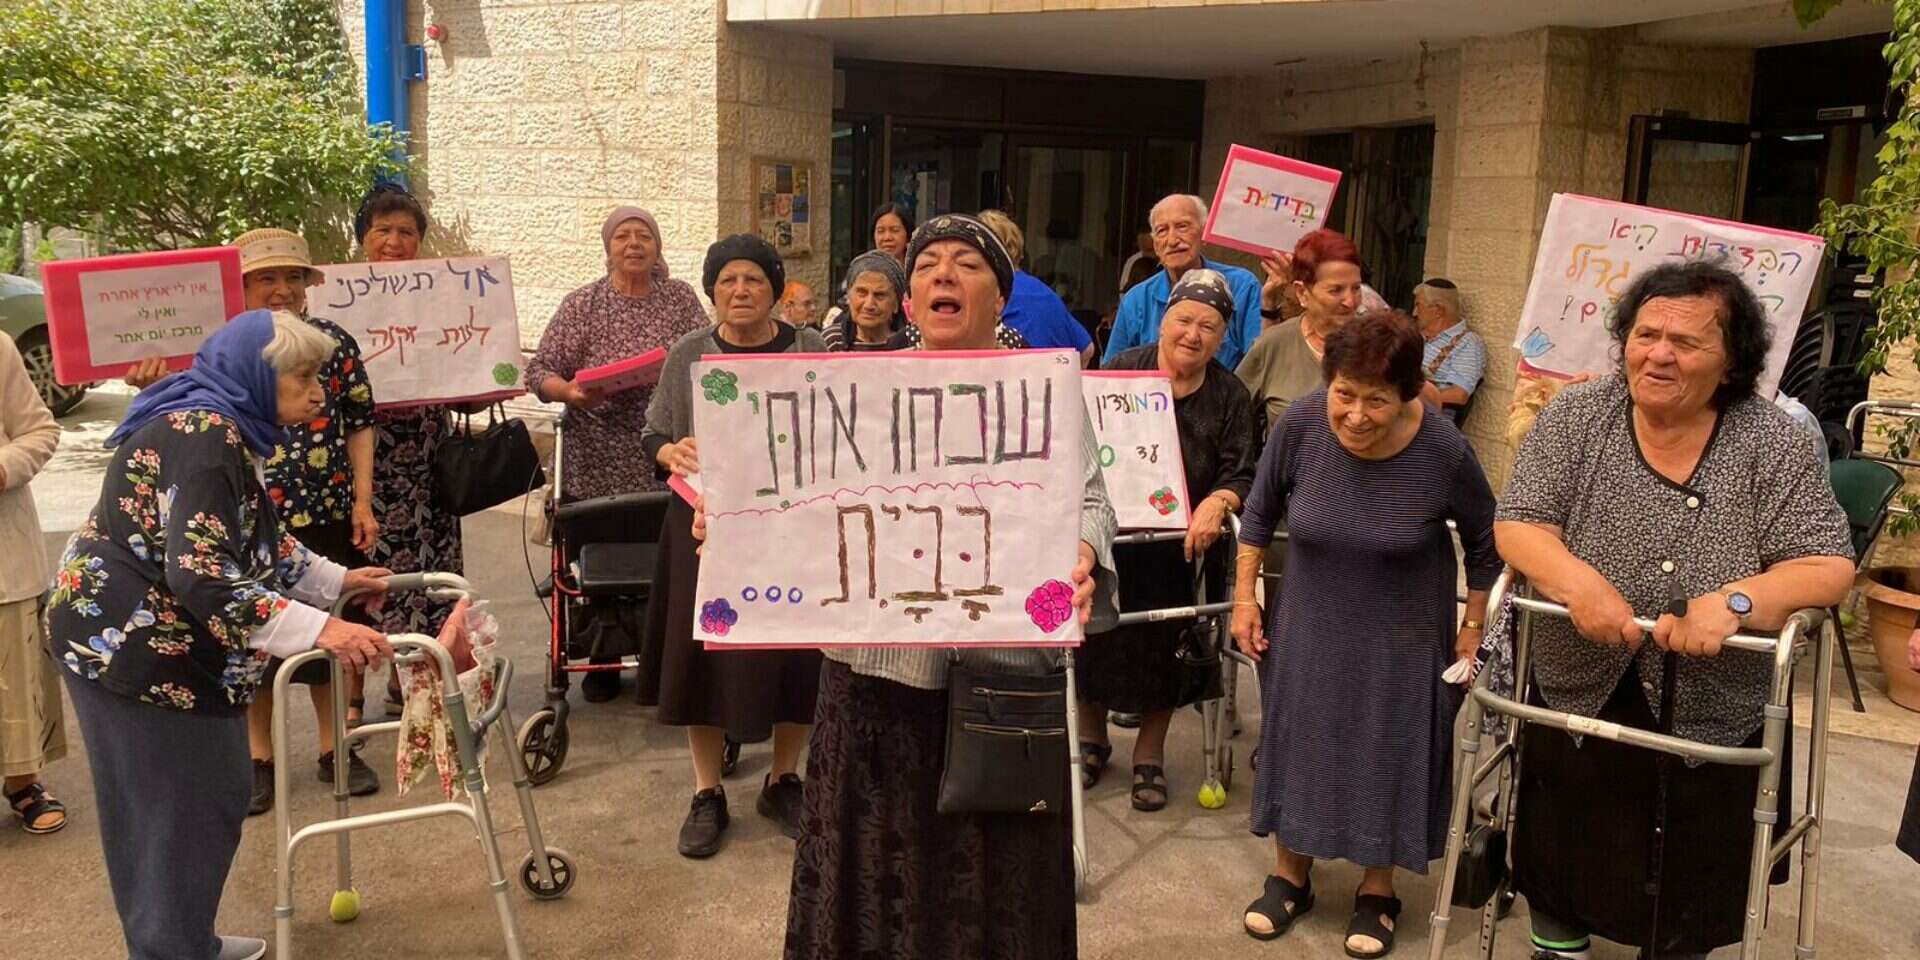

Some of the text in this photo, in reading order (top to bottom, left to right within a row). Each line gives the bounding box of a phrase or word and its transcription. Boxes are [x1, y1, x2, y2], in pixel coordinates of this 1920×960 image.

[446, 259, 500, 298] אל
[98, 281, 209, 303] אין לי ארץ אחרת
[138, 305, 177, 321] ואין לי
[114, 332, 145, 344] אחר
[171, 325, 204, 337] מרכז
[1095, 391, 1170, 432] המועדון
[890, 377, 1052, 474] שכחו
[1135, 443, 1160, 464] עד
